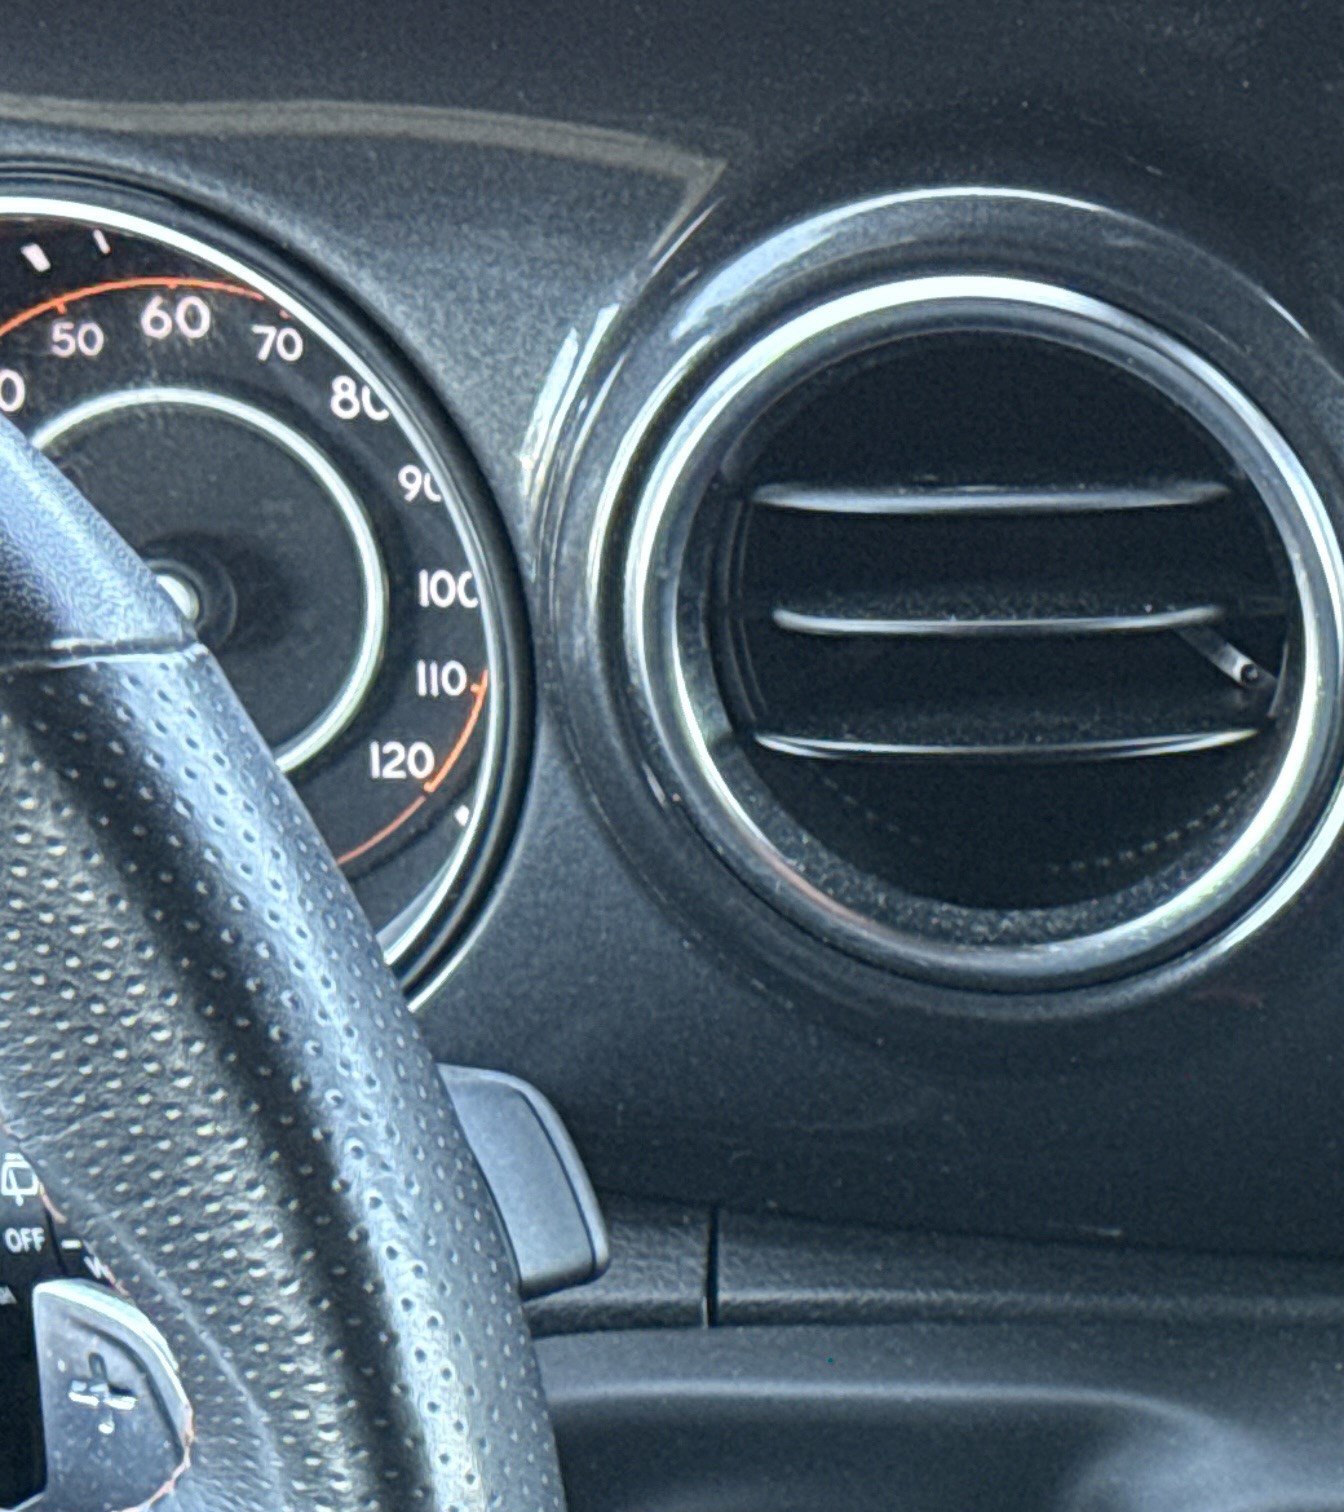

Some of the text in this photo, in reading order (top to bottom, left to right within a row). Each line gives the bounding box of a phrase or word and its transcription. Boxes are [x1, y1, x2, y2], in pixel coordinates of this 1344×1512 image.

[139, 294, 212, 341] 60
[50, 320, 105, 359] 50
[251, 324, 304, 362] 70
[415, 659, 469, 698] 110
[367, 739, 435, 777] 120
[3, 1226, 46, 1254] OFF
